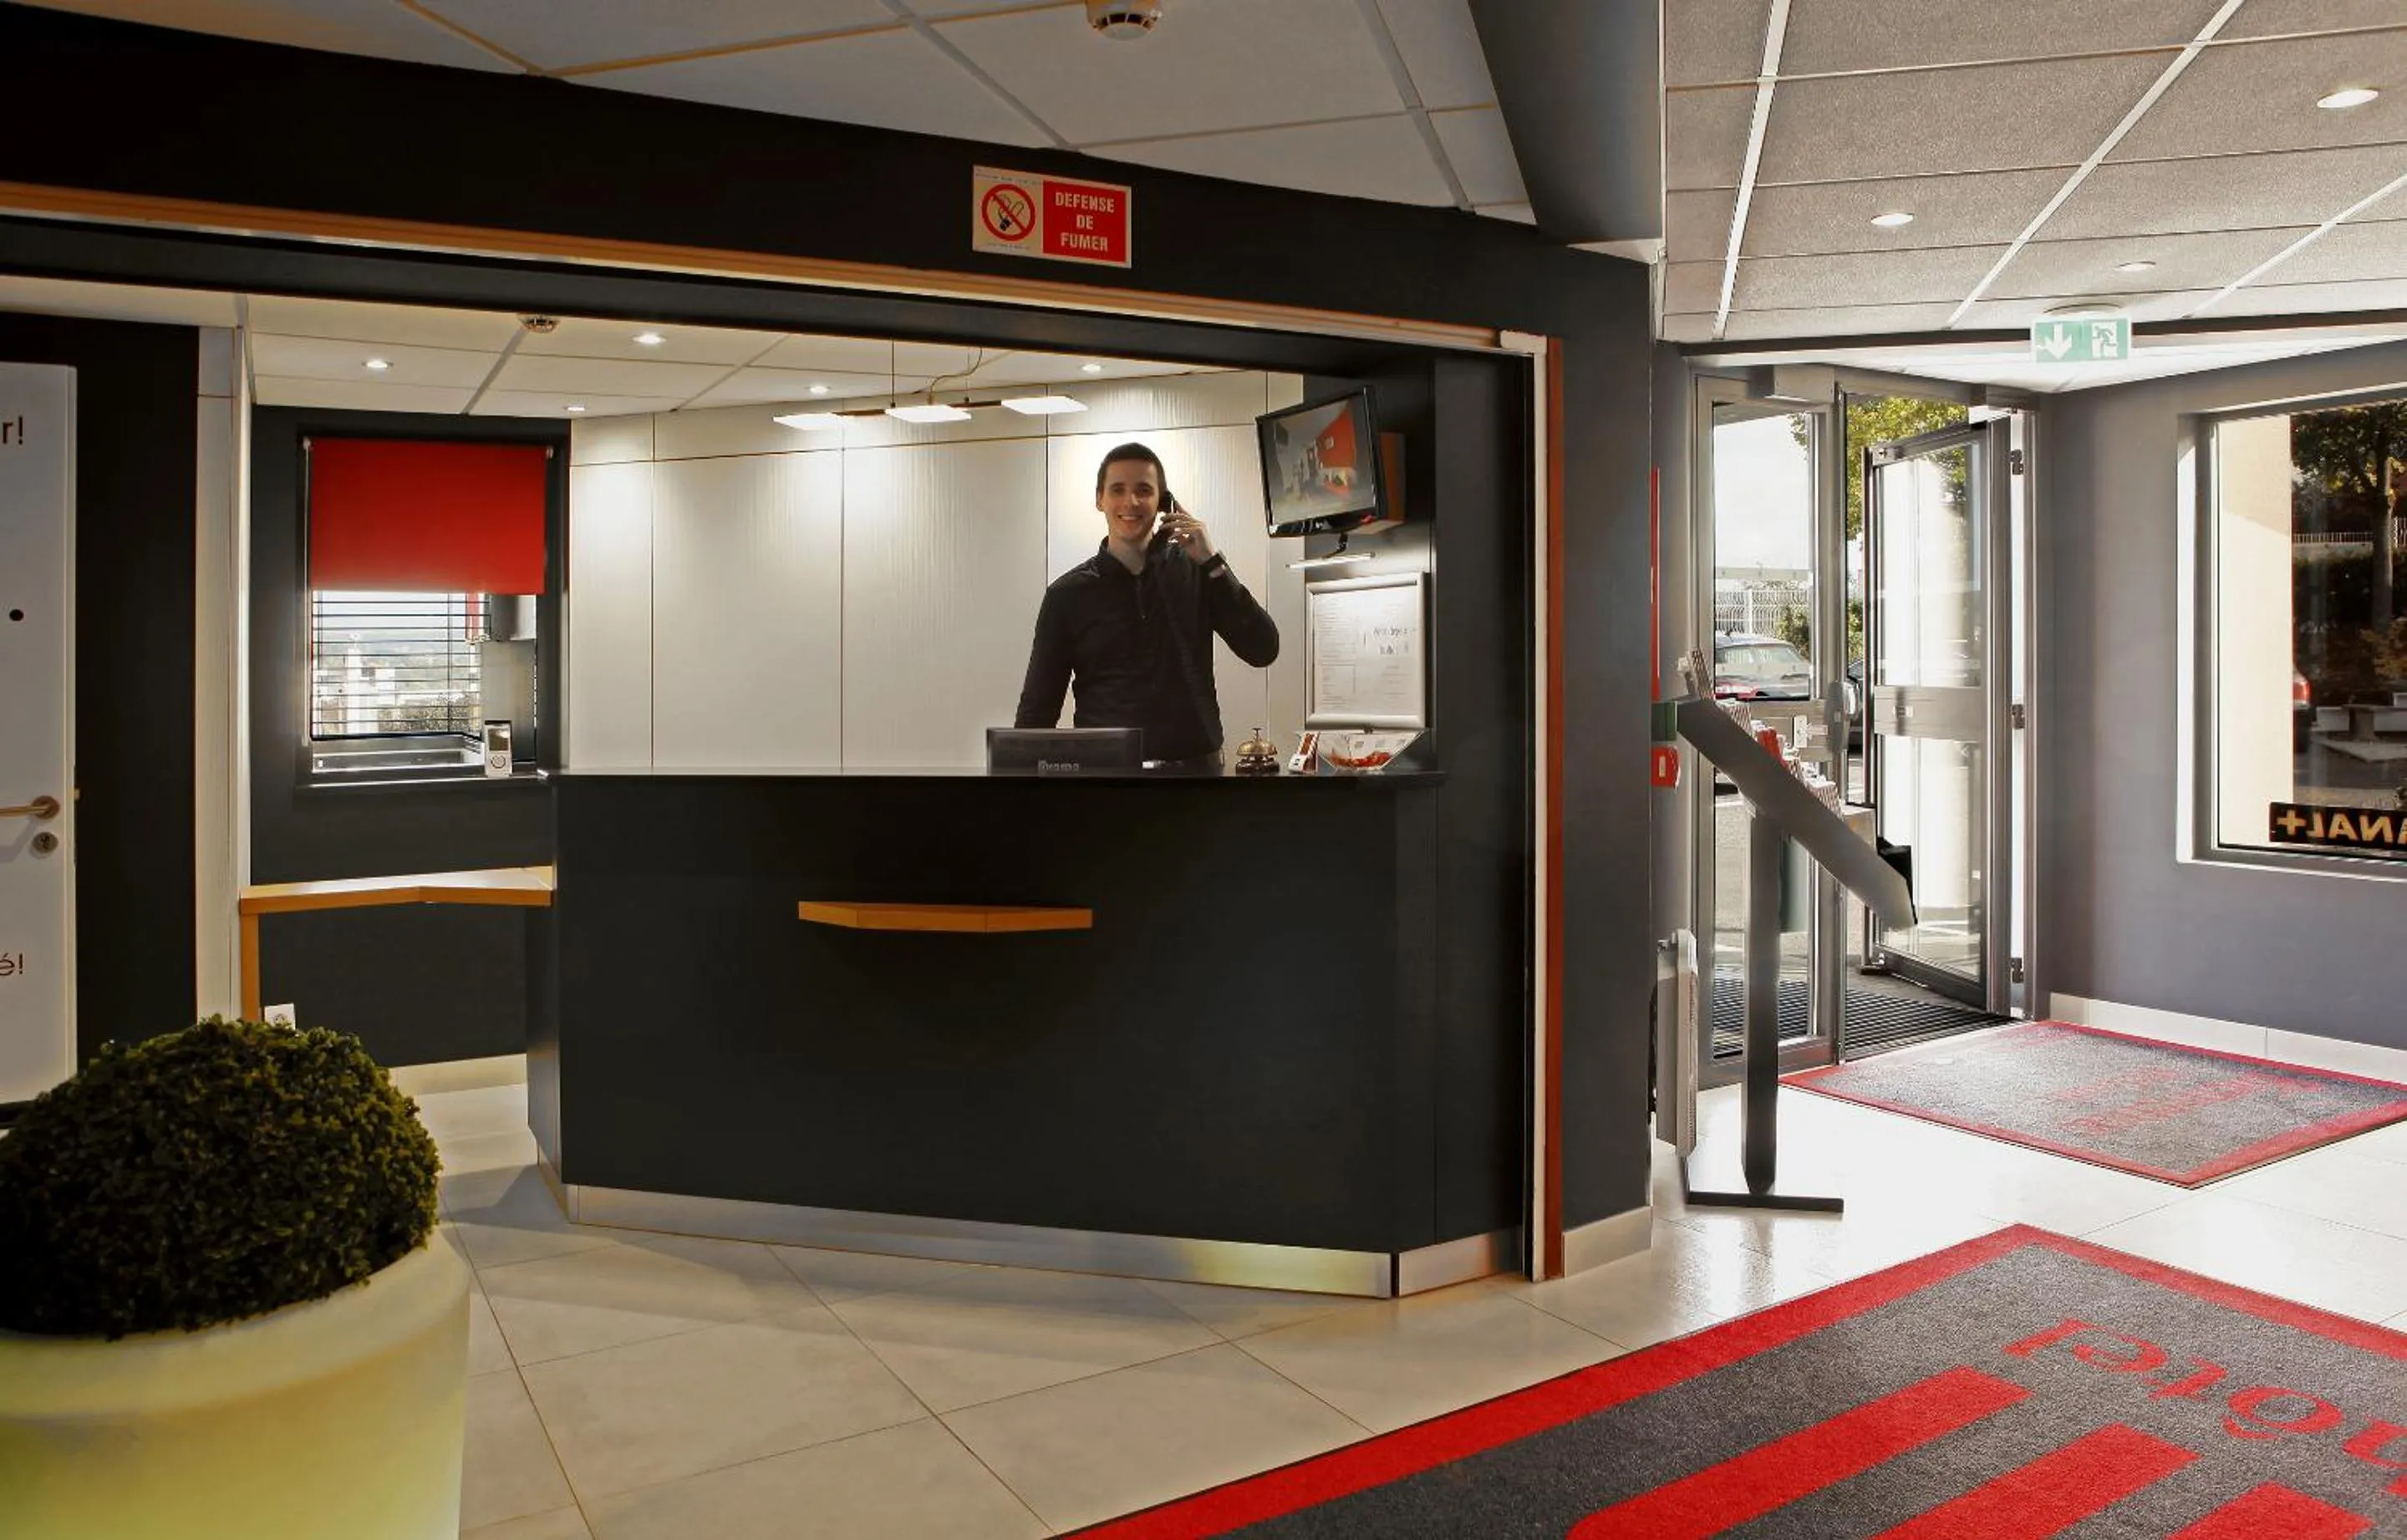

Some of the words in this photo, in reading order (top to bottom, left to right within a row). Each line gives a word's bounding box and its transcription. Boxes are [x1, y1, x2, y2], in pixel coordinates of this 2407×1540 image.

[1055, 191, 1115, 213] DEFENSE
[1076, 215, 1094, 231] DE
[1060, 232, 1109, 252] FUMER
